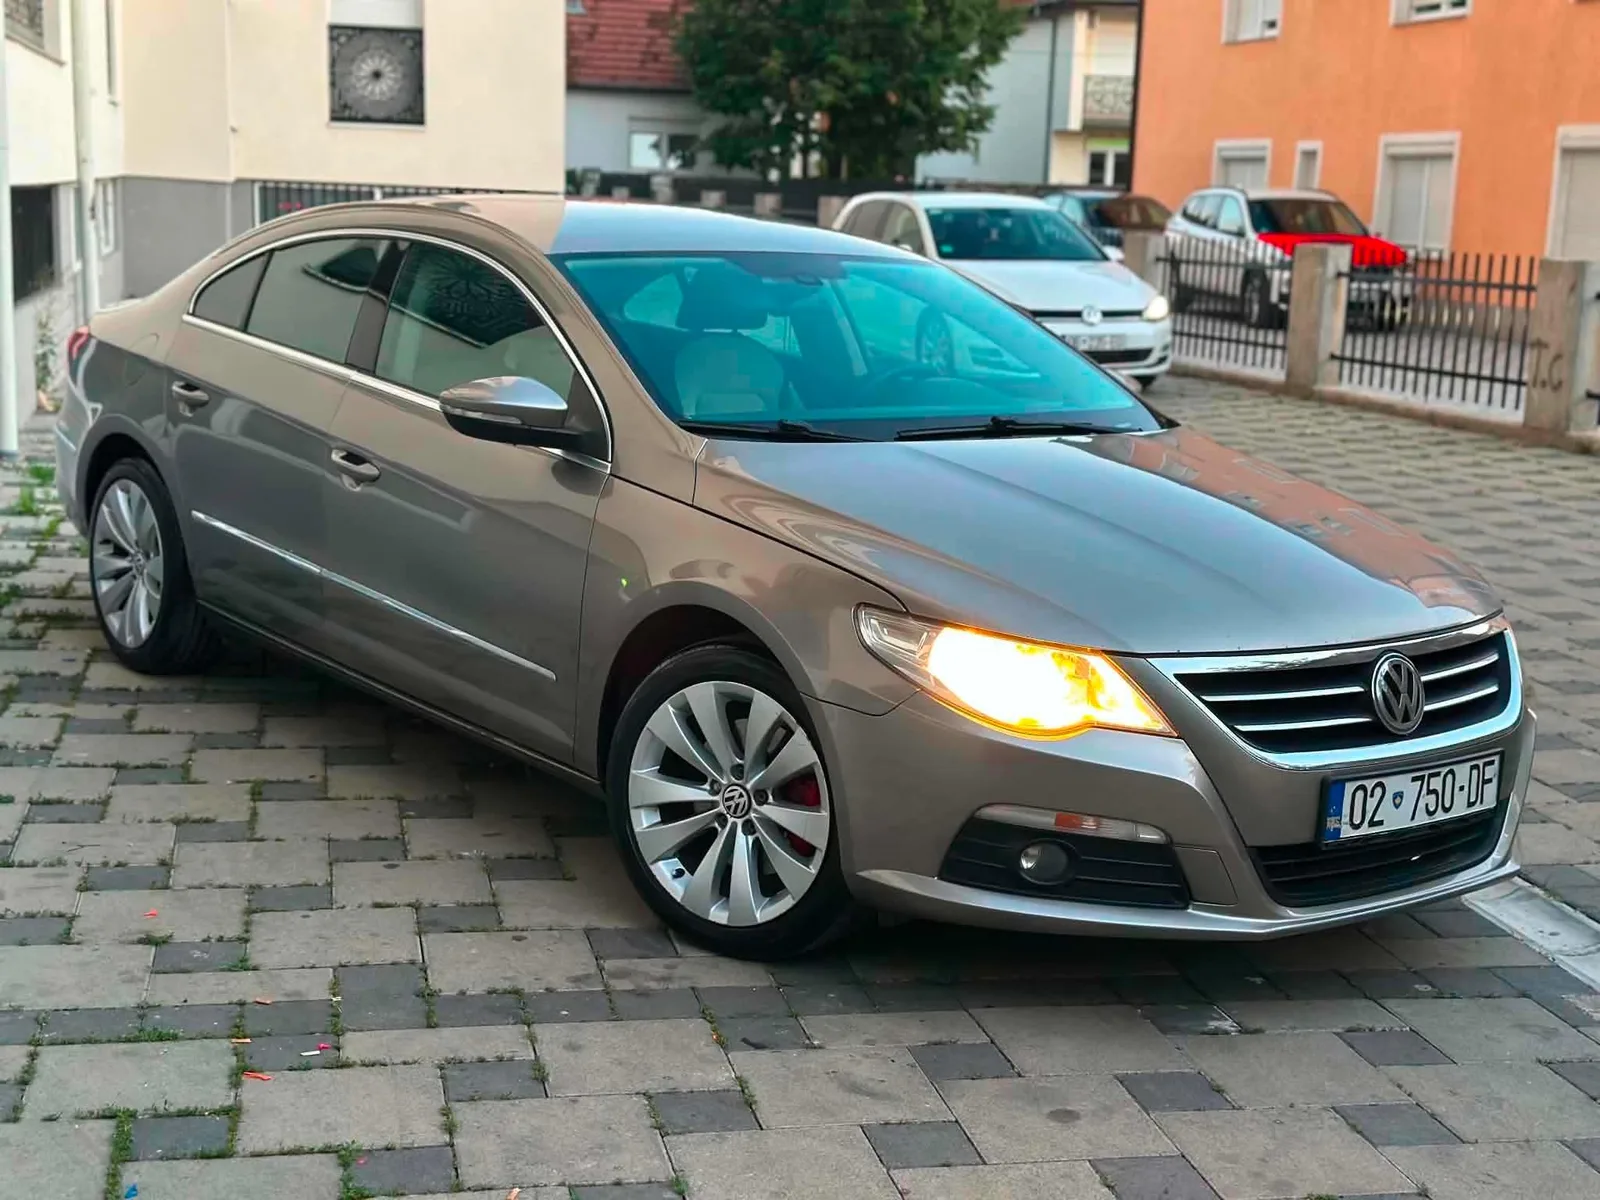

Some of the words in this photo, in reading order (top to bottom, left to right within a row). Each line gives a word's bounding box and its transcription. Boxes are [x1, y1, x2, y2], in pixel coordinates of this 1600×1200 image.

[1374, 655, 1422, 729] VW
[723, 784, 749, 817] VW
[1349, 780, 1387, 830] 02
